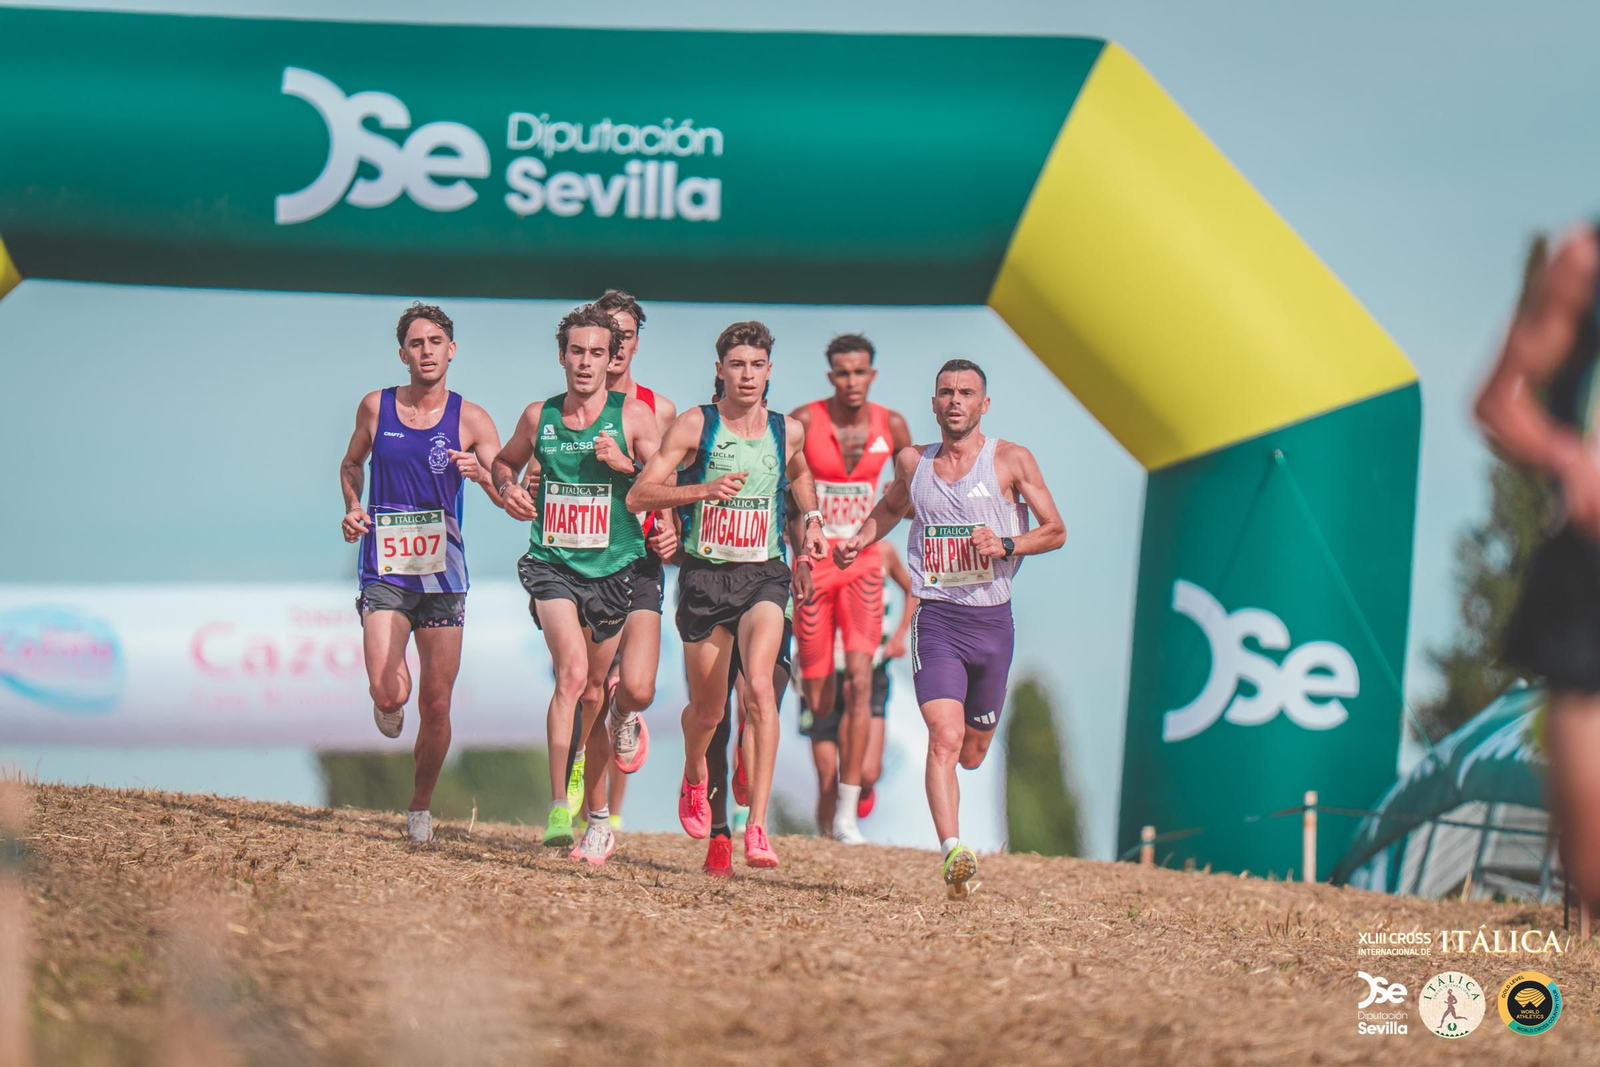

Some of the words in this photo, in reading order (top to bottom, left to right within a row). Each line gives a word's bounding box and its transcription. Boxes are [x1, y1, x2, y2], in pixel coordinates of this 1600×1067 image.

[506, 111, 724, 158] Diputación
[504, 155, 722, 222] Sevilla
[712, 451, 735, 459] UCLM
[544, 498, 608, 534] MARTÍN
[700, 505, 768, 548] MIGALLON
[816, 495, 869, 526] ARROS
[383, 534, 441, 558] 5107
[924, 538, 945, 573] RUI
[947, 537, 990, 573] PINTO
